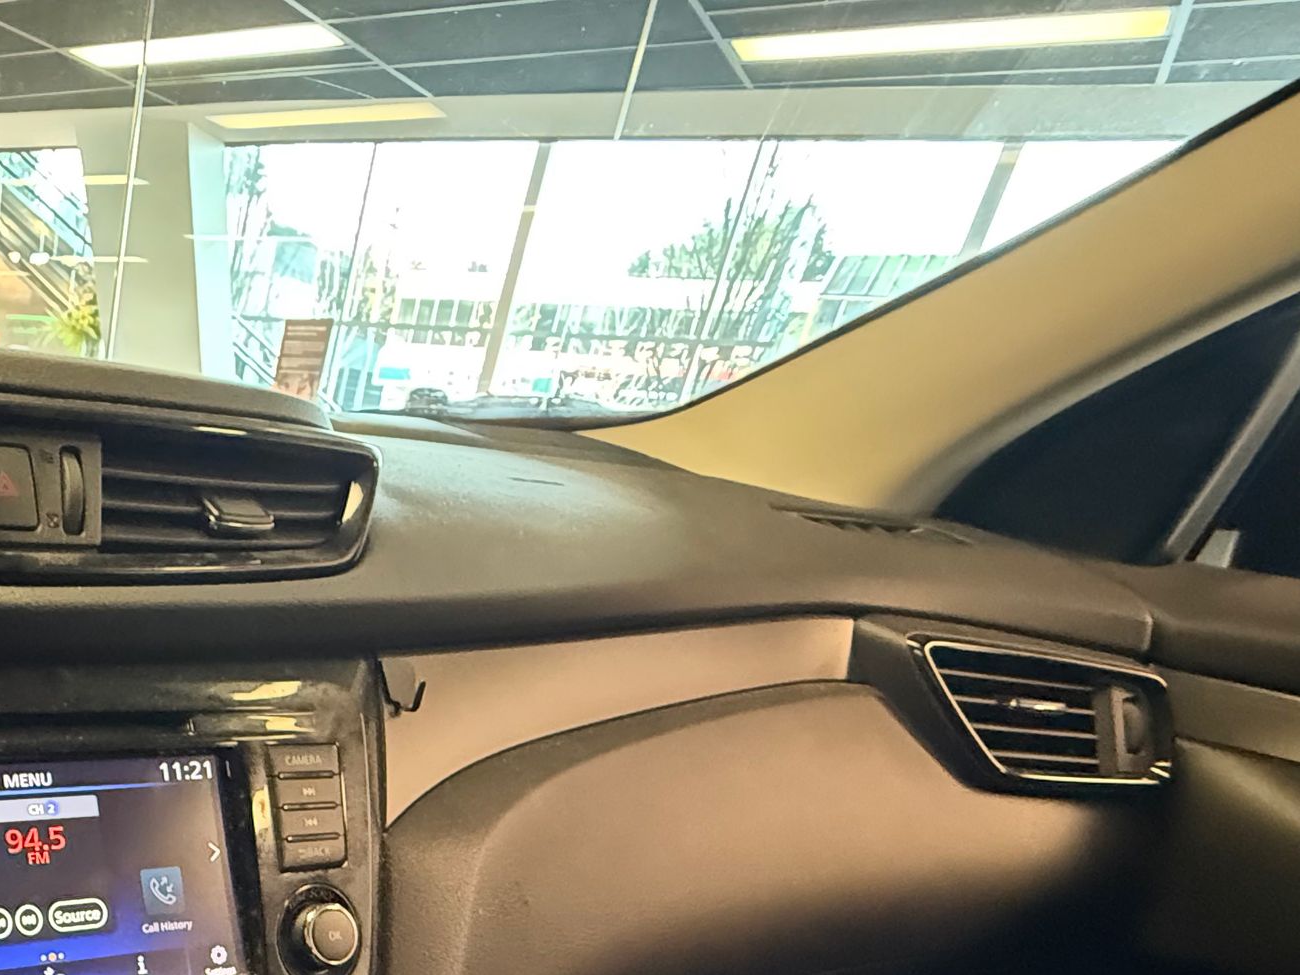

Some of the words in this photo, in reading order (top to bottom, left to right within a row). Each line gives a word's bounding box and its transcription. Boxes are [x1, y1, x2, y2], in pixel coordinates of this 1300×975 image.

[285, 753, 323, 766] CAMERA
[159, 760, 214, 781] 11:21
[2, 772, 53, 789] MENU
[27, 803, 45, 816] CH
[4, 825, 67, 854] 94.5
[27, 851, 51, 865] FM
[54, 909, 101, 924] Source
[142, 922, 160, 934] Call
[160, 920, 193, 933] History
